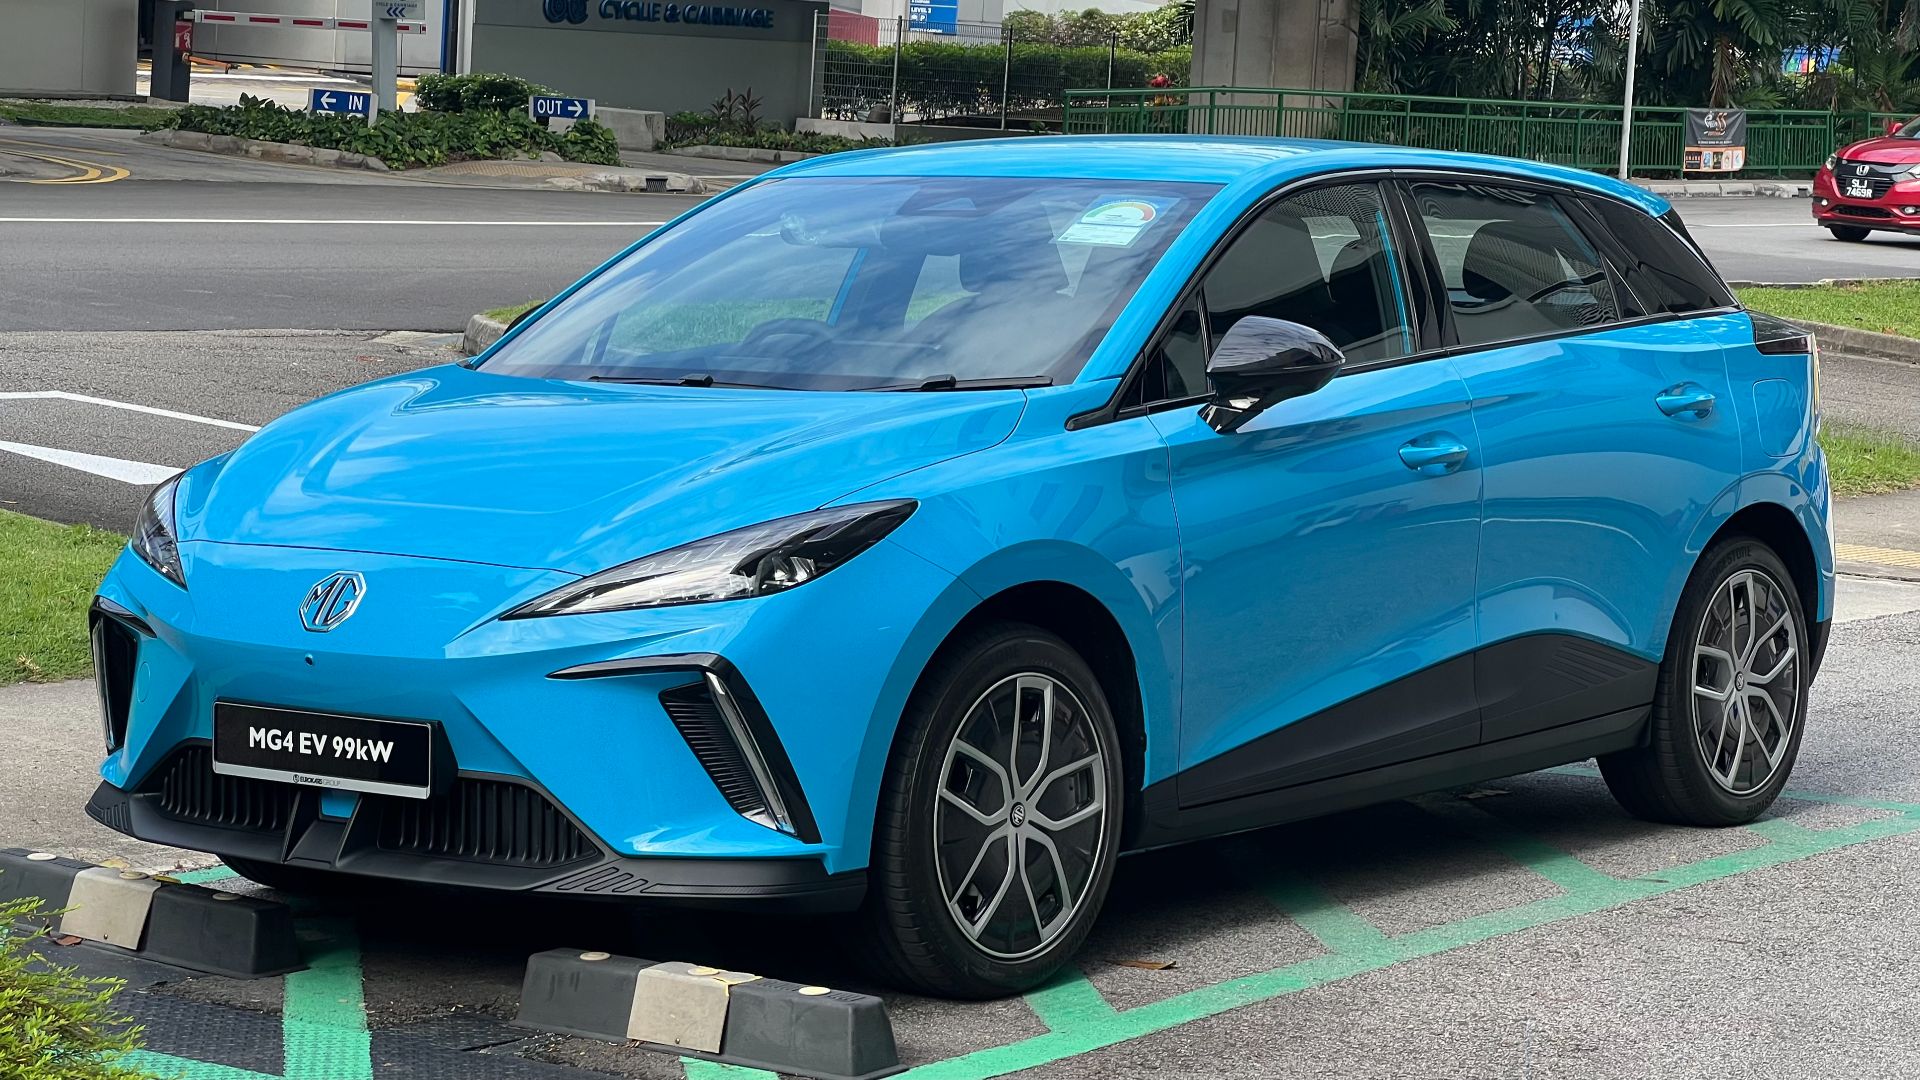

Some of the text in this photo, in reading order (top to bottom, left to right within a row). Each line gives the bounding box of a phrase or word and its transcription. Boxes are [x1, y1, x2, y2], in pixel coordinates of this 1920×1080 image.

[599, 0, 661, 22] CYCLE
[663, 3, 680, 23] &
[349, 95, 363, 110] IN
[537, 99, 562, 115] OUT
[1851, 179, 1868, 189] SLJ
[1846, 187, 1873, 198] 7469R
[302, 573, 362, 627] MG
[249, 726, 394, 763] MG4 EV 99kW
